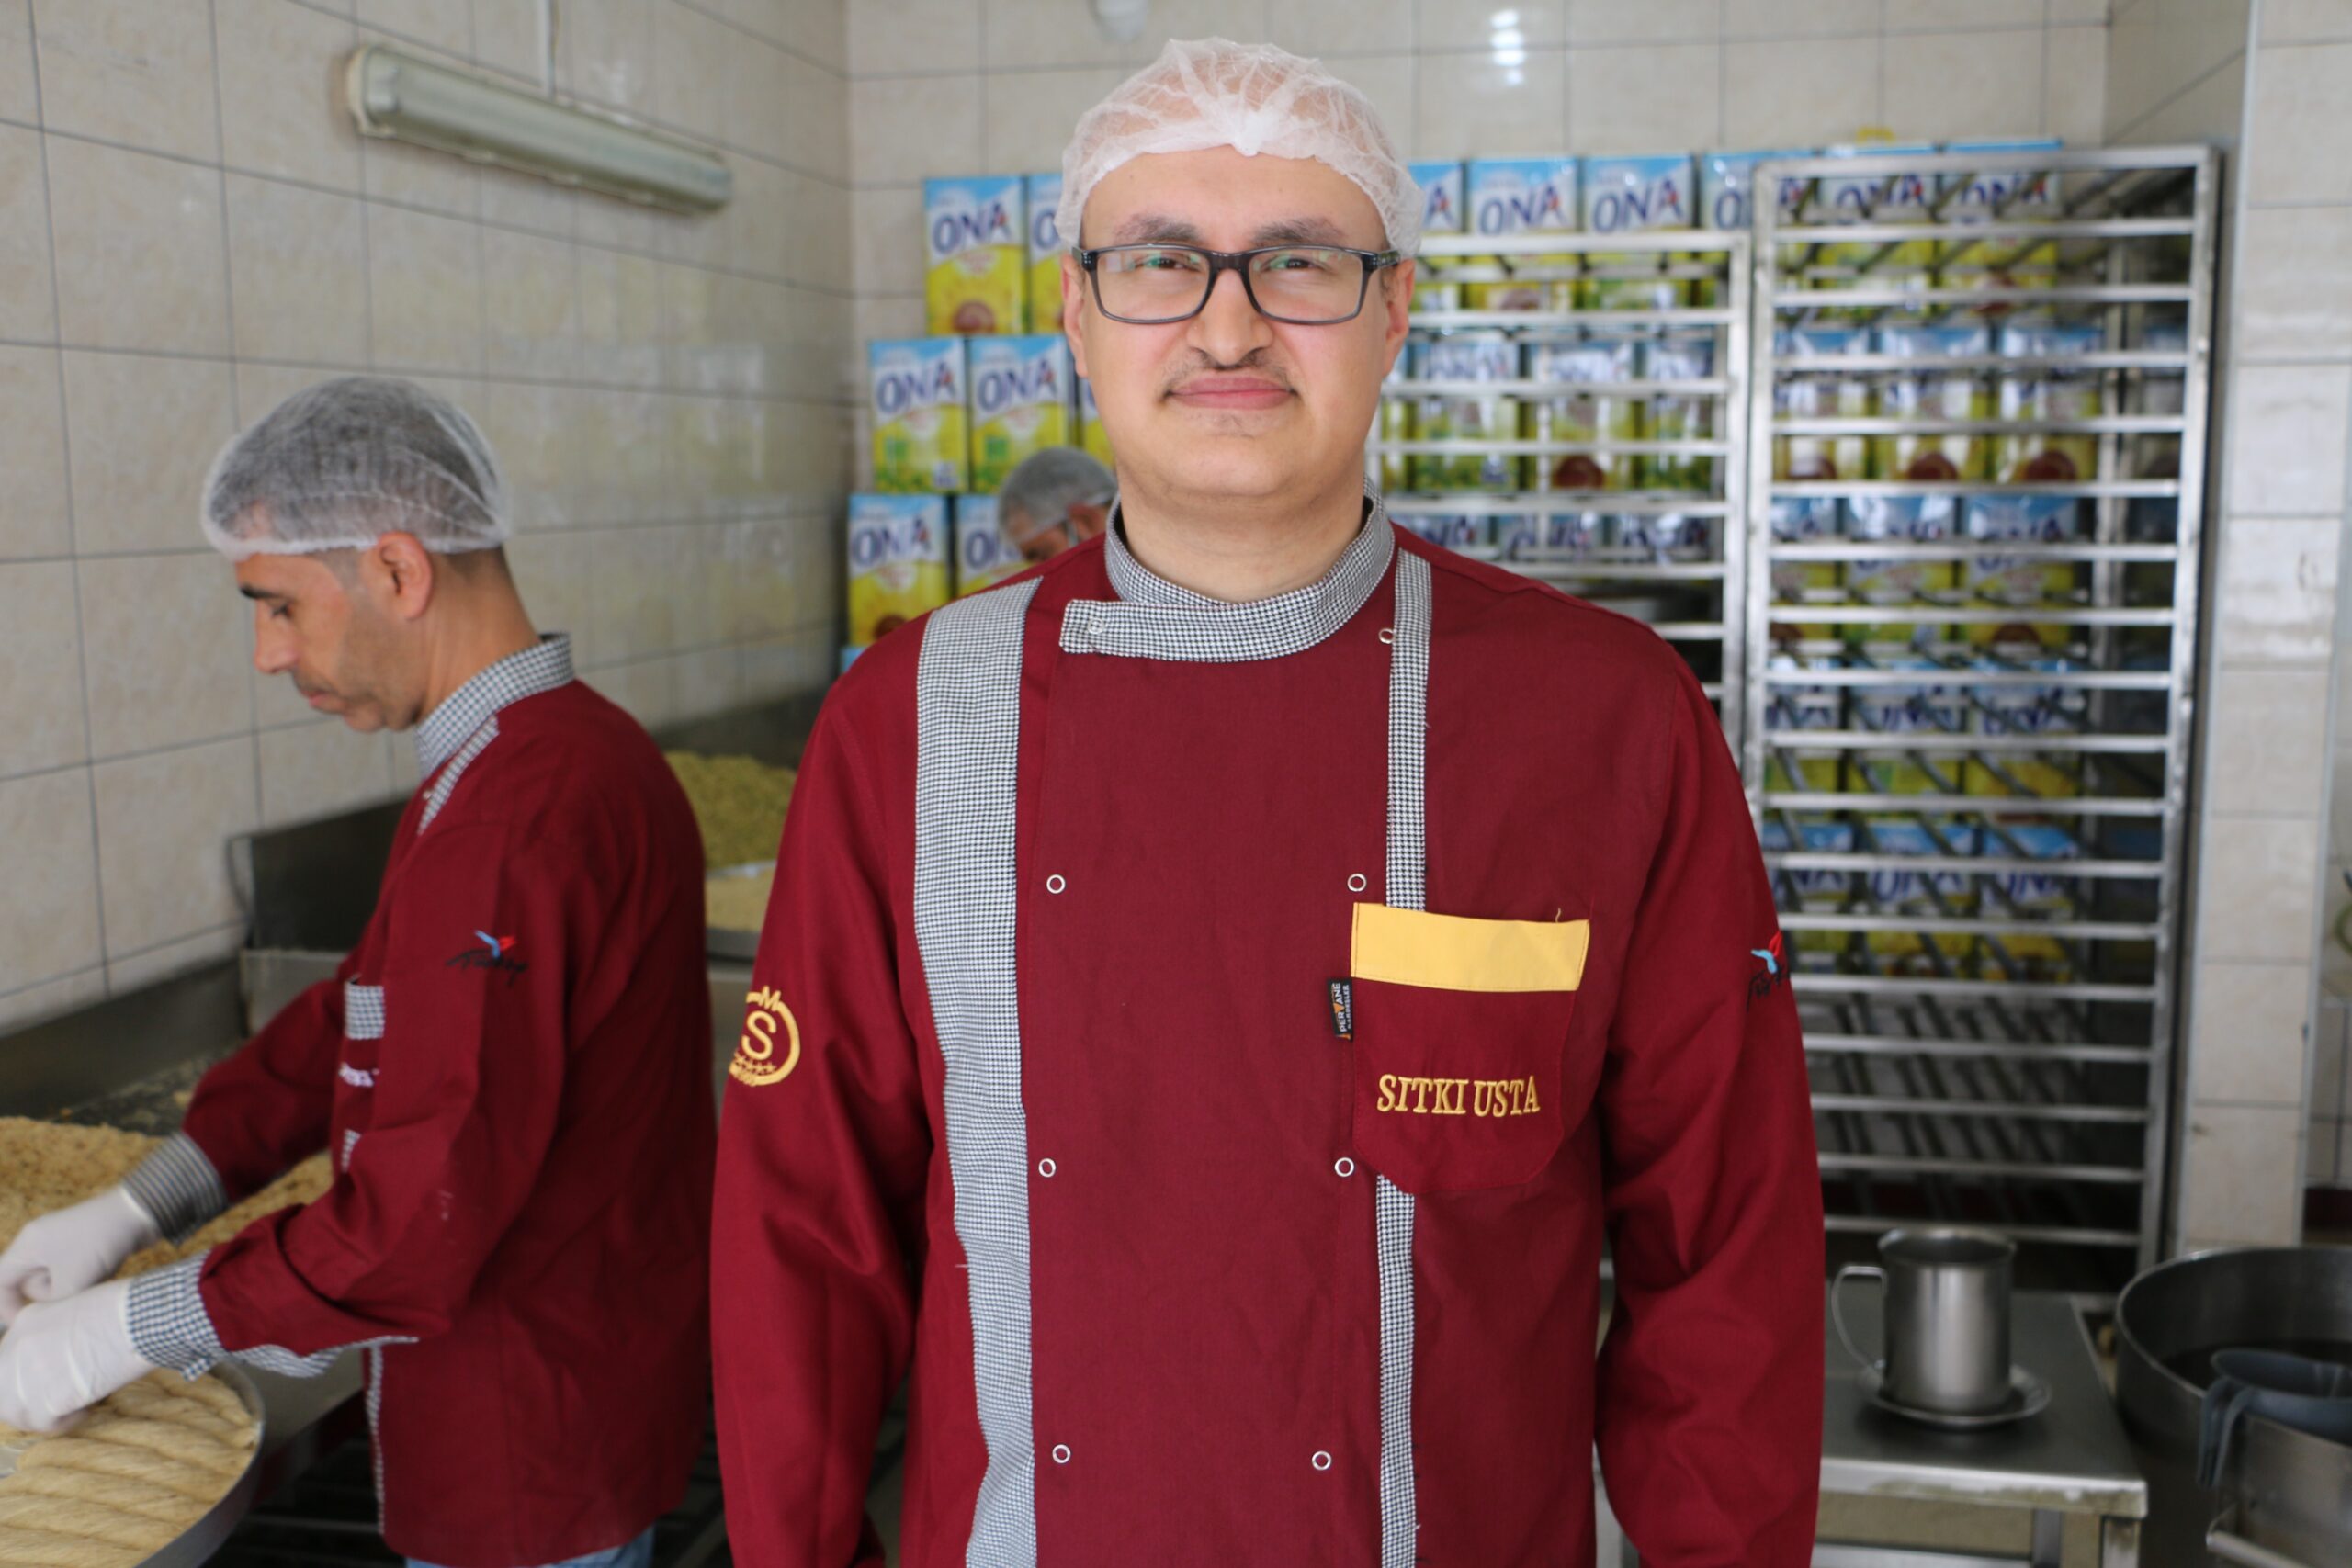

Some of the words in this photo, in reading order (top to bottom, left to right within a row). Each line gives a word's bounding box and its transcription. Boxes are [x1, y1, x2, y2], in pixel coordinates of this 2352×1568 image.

[932, 201, 1010, 255] ONA
[1479, 184, 1568, 235] ONA
[1593, 178, 1688, 234] ONA
[876, 362, 956, 414] ONA
[977, 358, 1058, 413] ONA
[851, 514, 932, 571] ONA
[1376, 1073, 1469, 1115] SITKI
[1474, 1075, 1541, 1118] USTA
